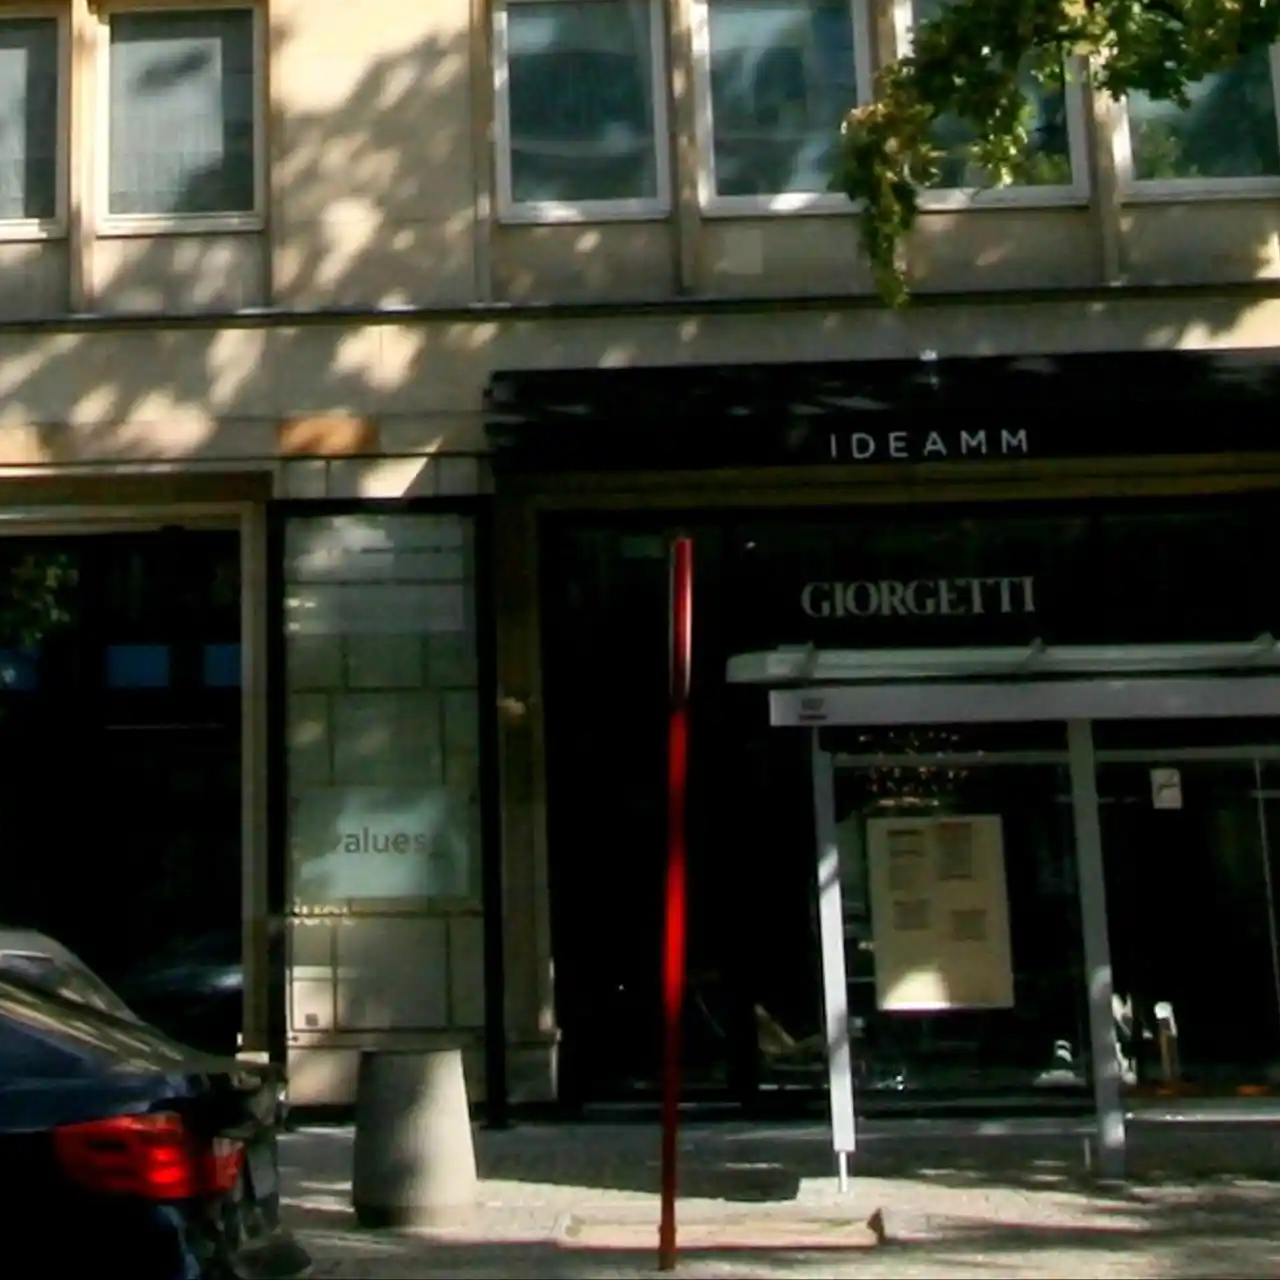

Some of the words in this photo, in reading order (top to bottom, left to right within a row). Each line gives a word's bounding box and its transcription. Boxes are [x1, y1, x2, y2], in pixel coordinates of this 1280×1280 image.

[829, 428, 1030, 460] IDEAMM
[800, 576, 1036, 619] GIORGETTI
[328, 825, 429, 856] alues
